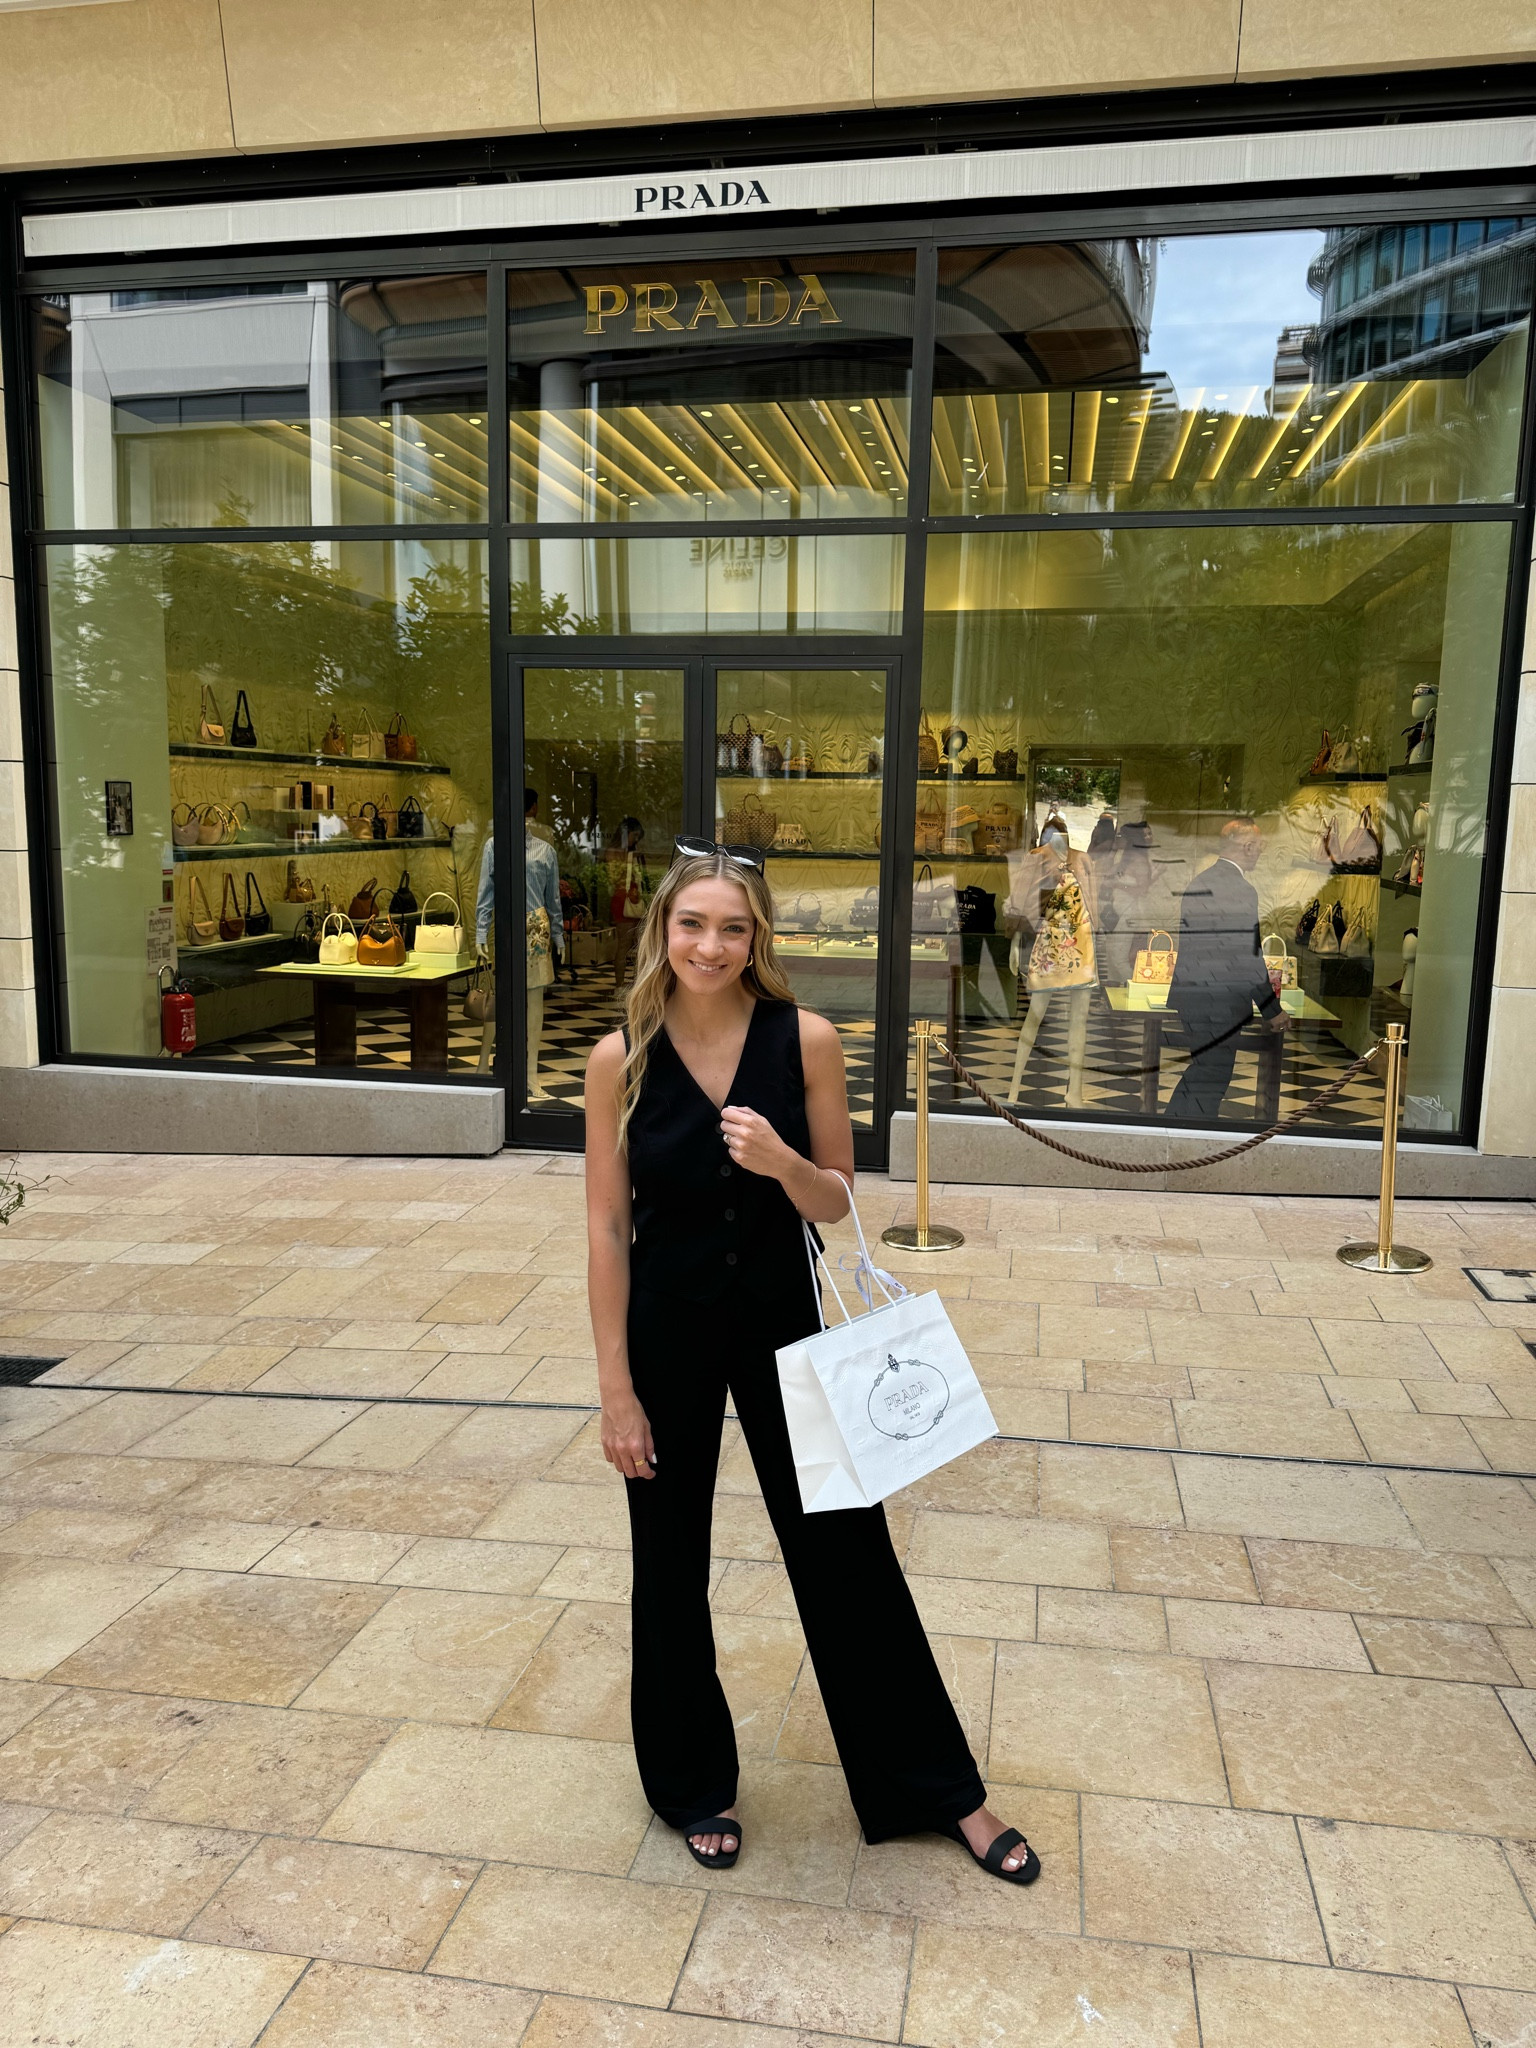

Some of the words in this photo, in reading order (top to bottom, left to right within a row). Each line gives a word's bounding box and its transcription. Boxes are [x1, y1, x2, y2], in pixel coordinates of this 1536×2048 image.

[634, 180, 771, 213] PRADA
[582, 274, 843, 334] PRADA
[884, 1381, 929, 1411] PRADA
[903, 1402, 921, 1415] MILANO
